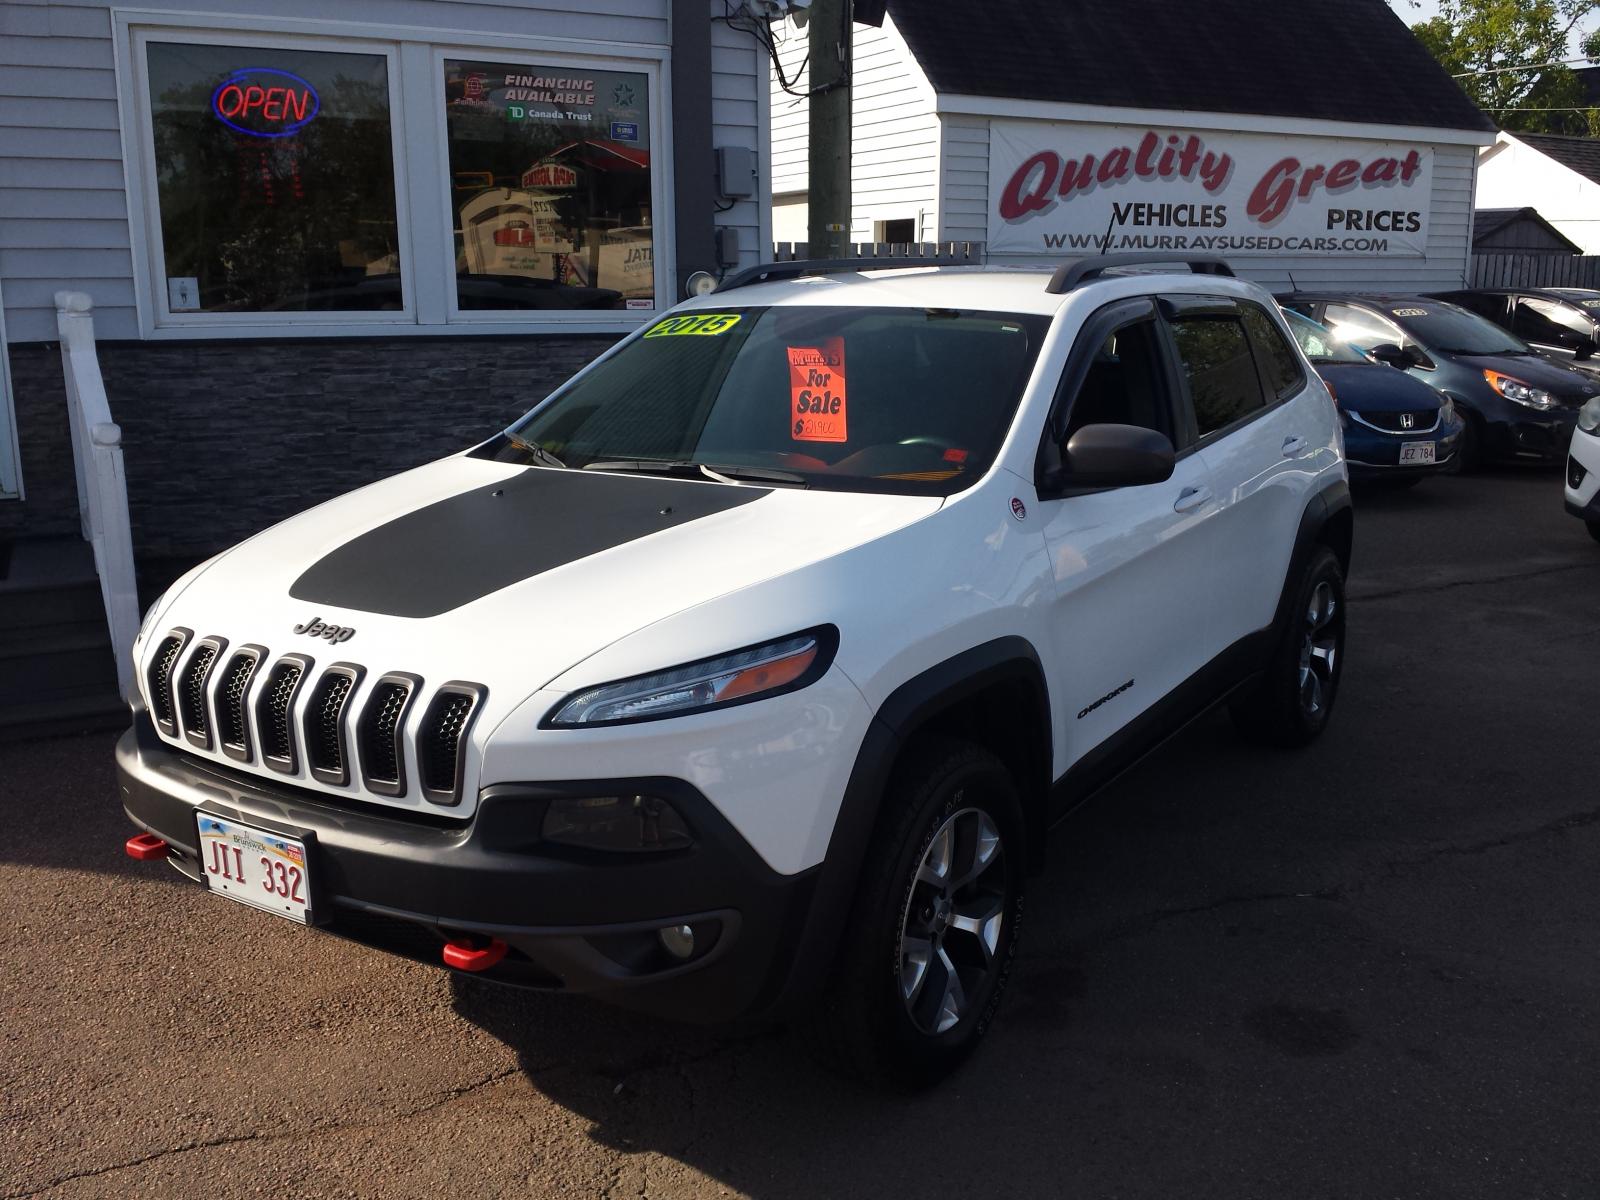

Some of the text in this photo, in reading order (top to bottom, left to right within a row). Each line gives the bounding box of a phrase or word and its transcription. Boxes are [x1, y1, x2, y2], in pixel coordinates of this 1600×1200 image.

[504, 74, 594, 91] FINANCING
[218, 85, 309, 120] OPEN
[504, 89, 596, 105] AVAILABLE
[509, 106, 593, 121] TD Canada Trust
[998, 130, 1421, 225] Quality Great
[1112, 202, 1421, 232] VEHICLES PRICES
[1043, 233, 1388, 252] WWW.MURRAYSUSEDCARS.COM
[648, 315, 737, 334] 2015
[806, 368, 831, 388] For
[796, 389, 842, 415] Sale
[1401, 446, 1434, 460] JEZ 784
[293, 616, 356, 645] Jeep
[208, 840, 306, 905] JII 332
